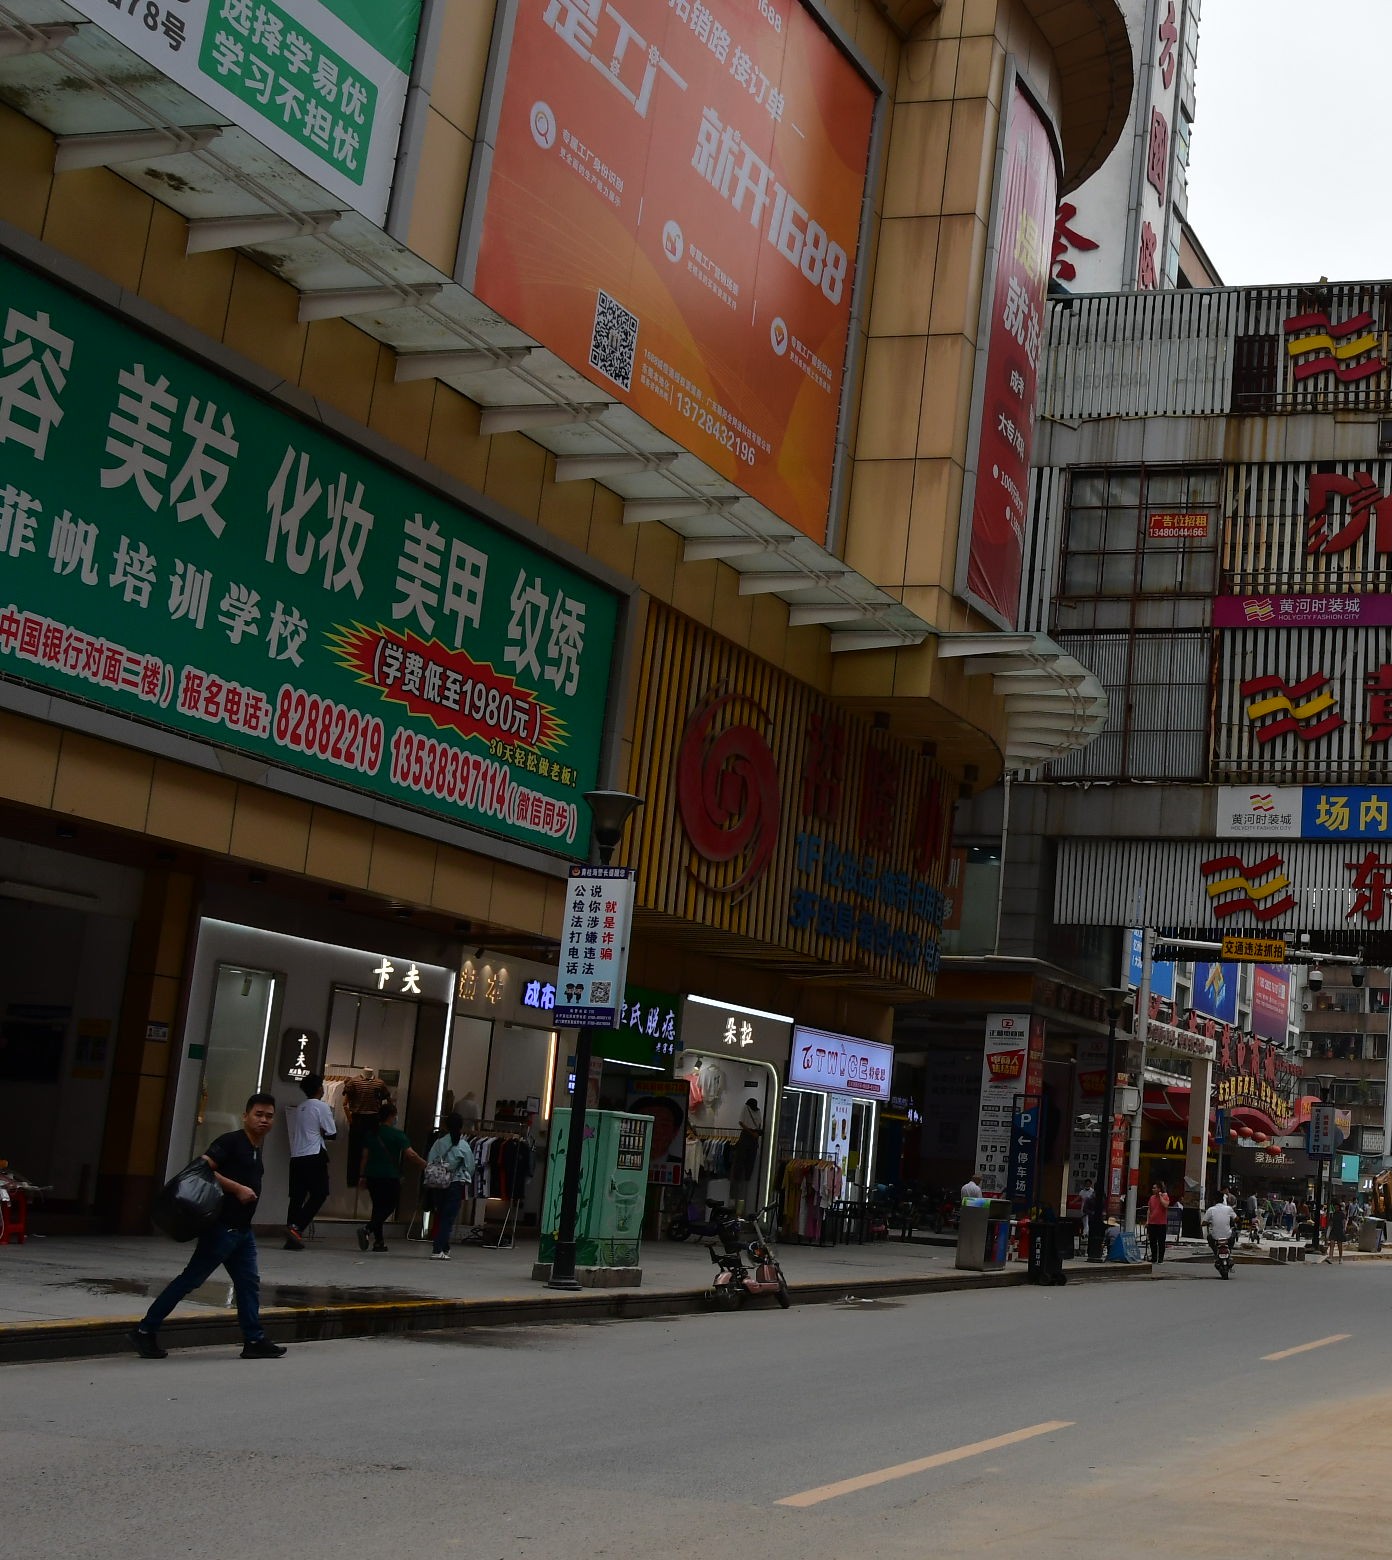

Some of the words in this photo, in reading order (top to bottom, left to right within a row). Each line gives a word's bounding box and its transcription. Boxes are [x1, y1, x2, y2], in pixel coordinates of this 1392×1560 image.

[220, 0, 368, 125] 选择学易优
[212, 30, 360, 170] 学习不担忧
[729, 46, 784, 122] 接订单
[691, 105, 848, 302] 就开1688
[677, 392, 756, 466] 13728432196
[100, 363, 240, 538] 美发
[264, 445, 375, 600] 化妆
[392, 513, 489, 650] 美甲
[503, 568, 586, 697] 纹绣
[1149, 528, 1203, 537] 13480044466
[1151, 514, 1207, 527] 广告位招租
[1279, 597, 1361, 613] 黄河时装城
[277, 690, 384, 773] 82882219
[1232, 813, 1292, 825] 黄河时装城
[600, 901, 617, 960] 就是诈骗
[1224, 941, 1283, 958] 交通违法抓拍
[372, 958, 421, 994] 卡夫
[297, 1033, 309, 1068] 卡夫
[723, 1017, 754, 1048] 朵拉
[1020, 1113, 1032, 1128] P
[1015, 1152, 1029, 1192] 停车场
